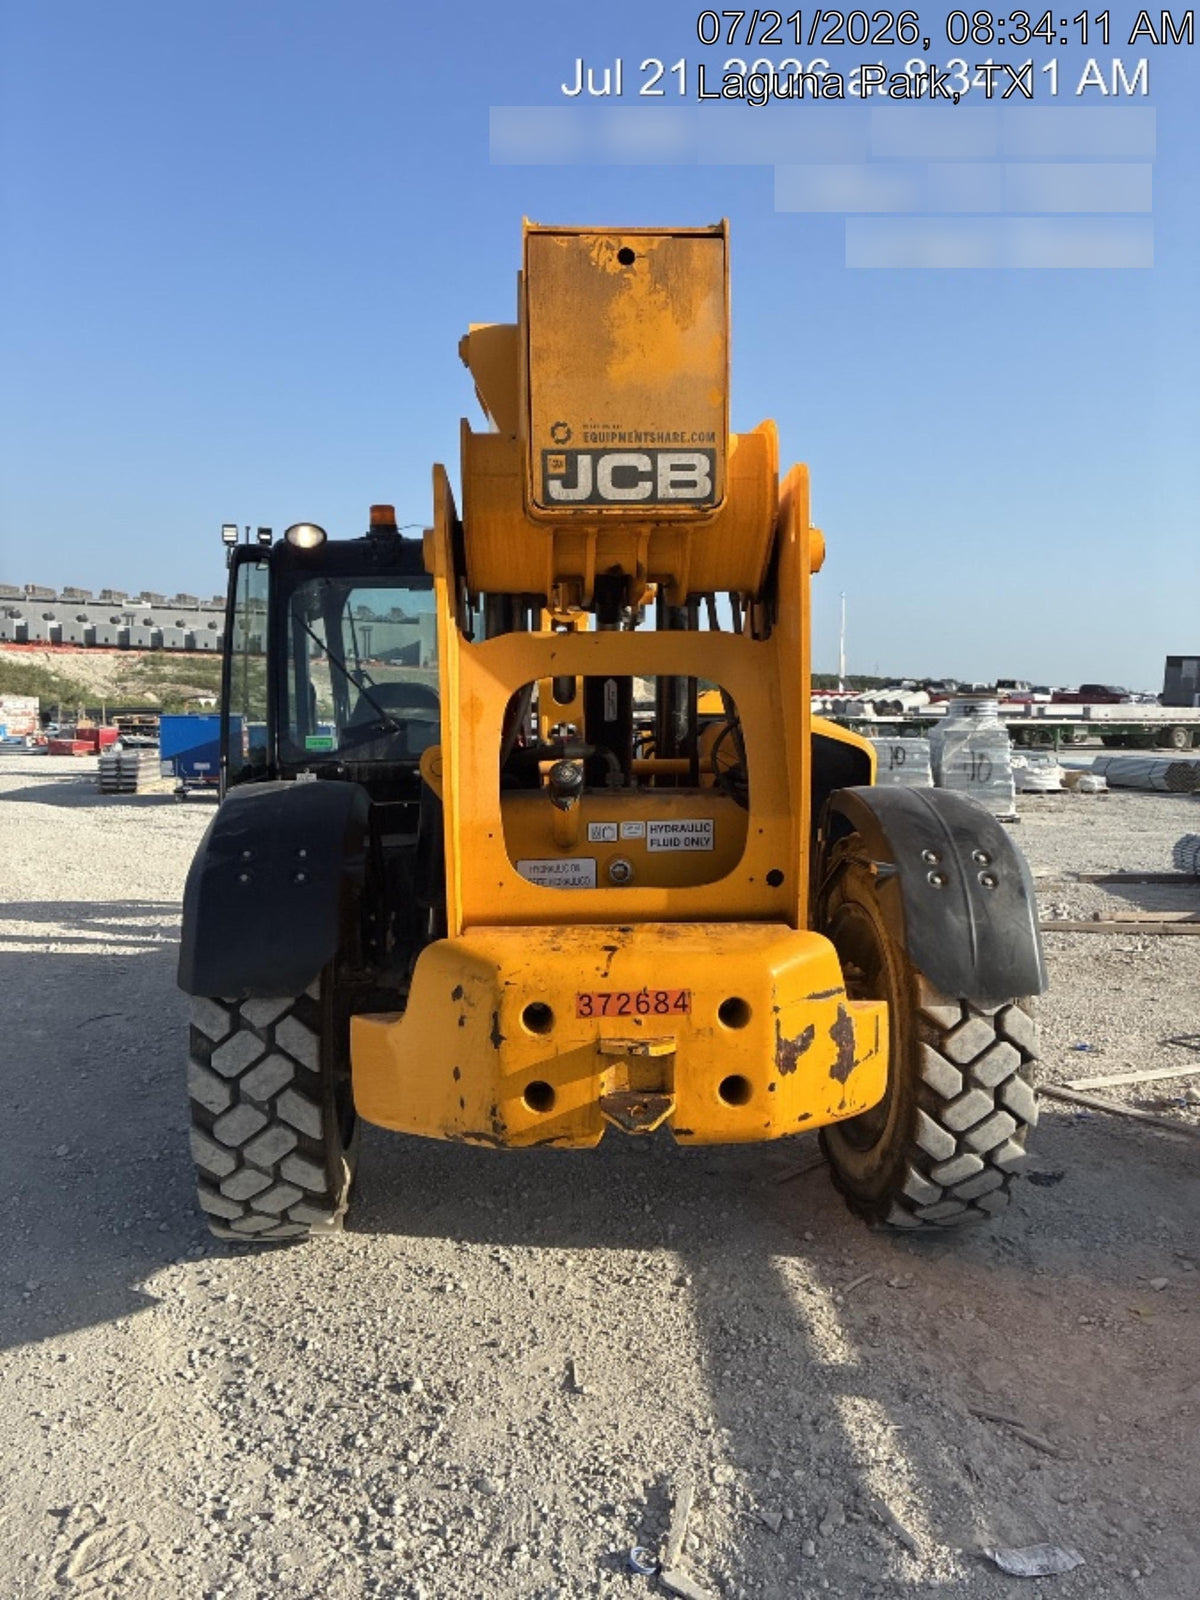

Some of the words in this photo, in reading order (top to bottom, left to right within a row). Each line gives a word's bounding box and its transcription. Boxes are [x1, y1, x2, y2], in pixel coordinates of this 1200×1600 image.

[583, 431, 716, 443] EQUIPMENTSHARE.COM
[548, 453, 712, 500] JCB
[650, 823, 712, 834] HYDRAULIC
[650, 837, 680, 847] FLUID
[684, 836, 711, 847] ONLY
[578, 991, 689, 1017] 372684
